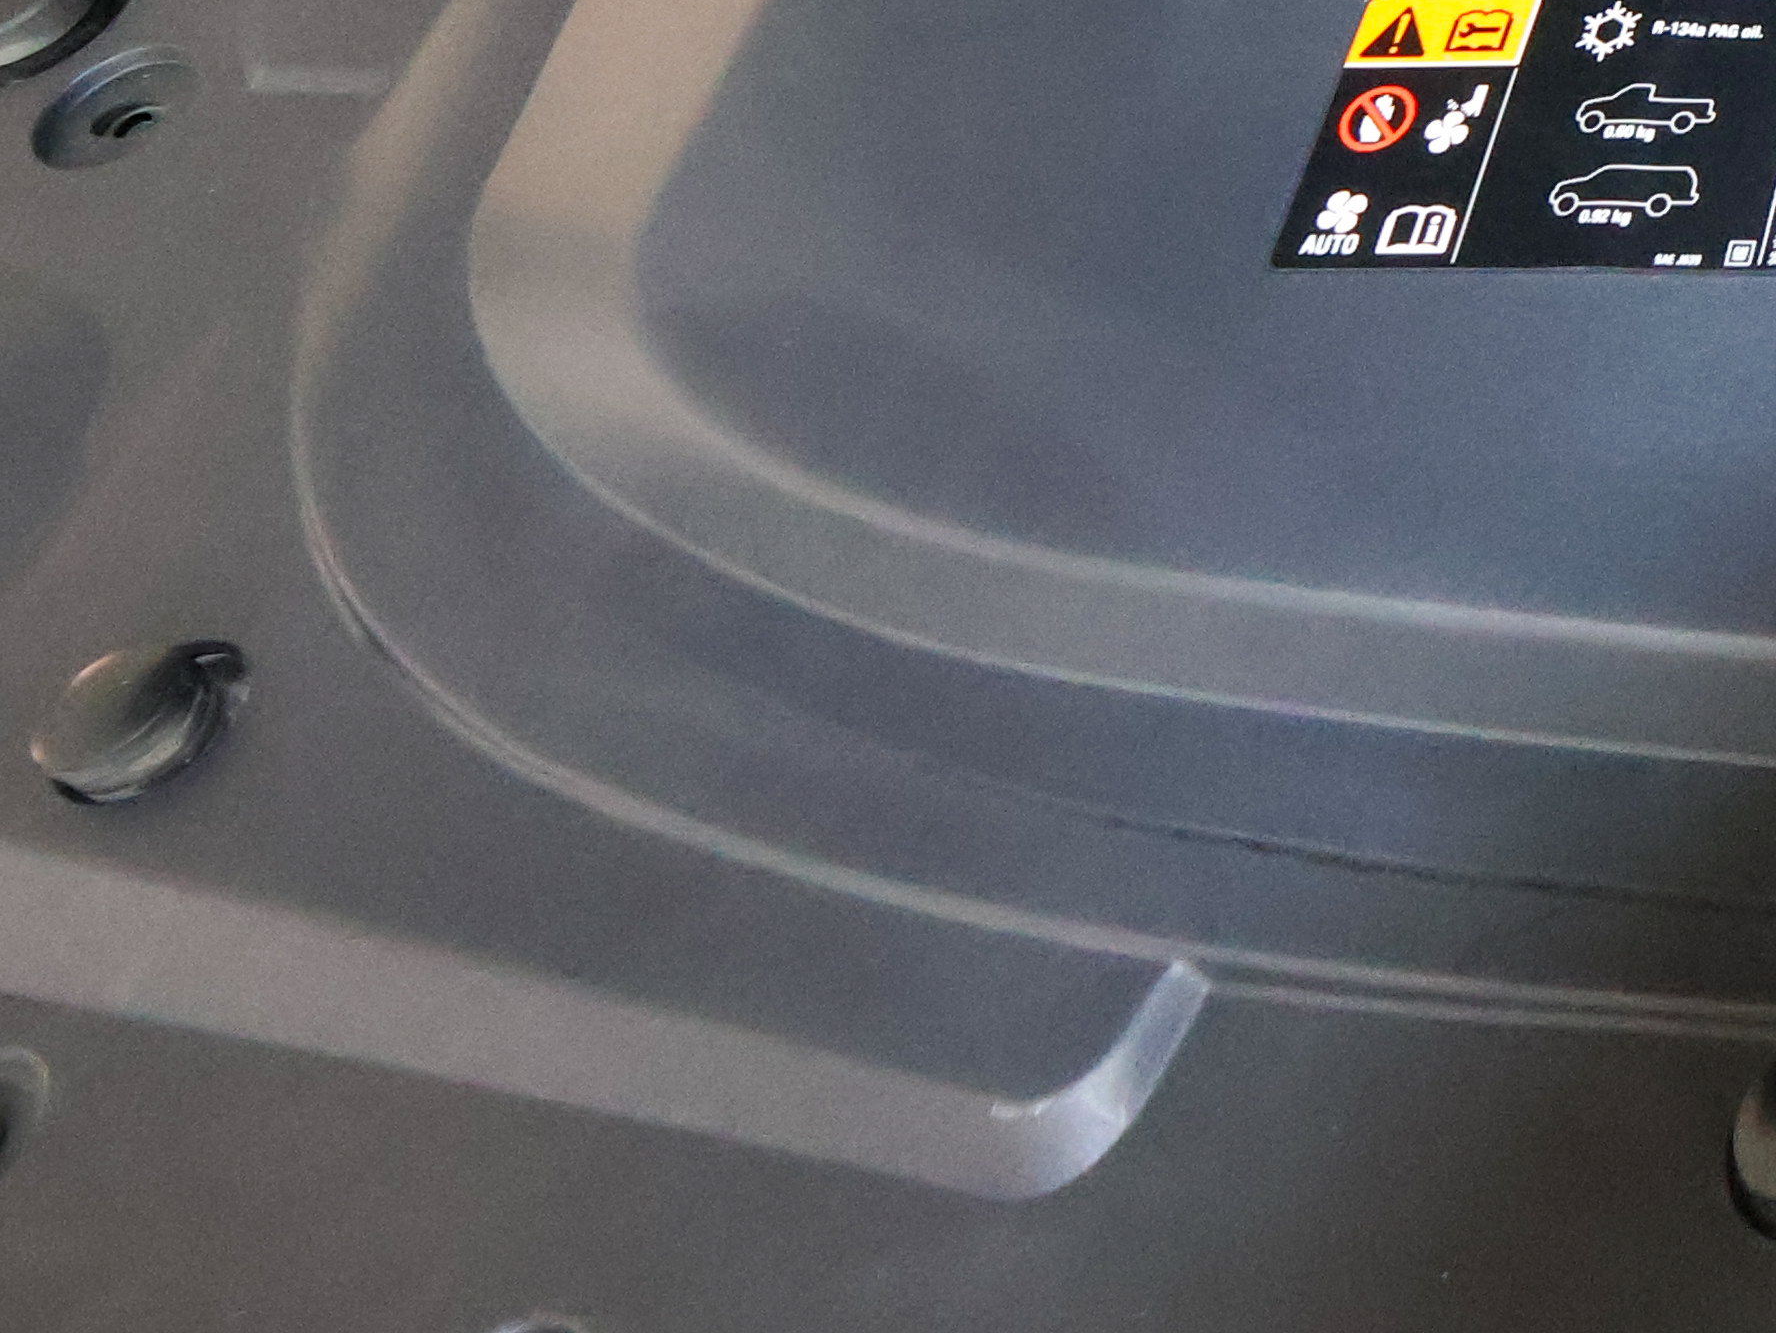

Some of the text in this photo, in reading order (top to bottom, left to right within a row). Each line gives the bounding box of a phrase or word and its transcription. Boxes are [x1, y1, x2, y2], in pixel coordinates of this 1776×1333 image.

[1652, 20, 1764, 39] R-134a PAG oil.
[1636, 125, 1656, 143] kg
[1611, 208, 1632, 228] kg
[1298, 233, 1360, 256] AUTO
